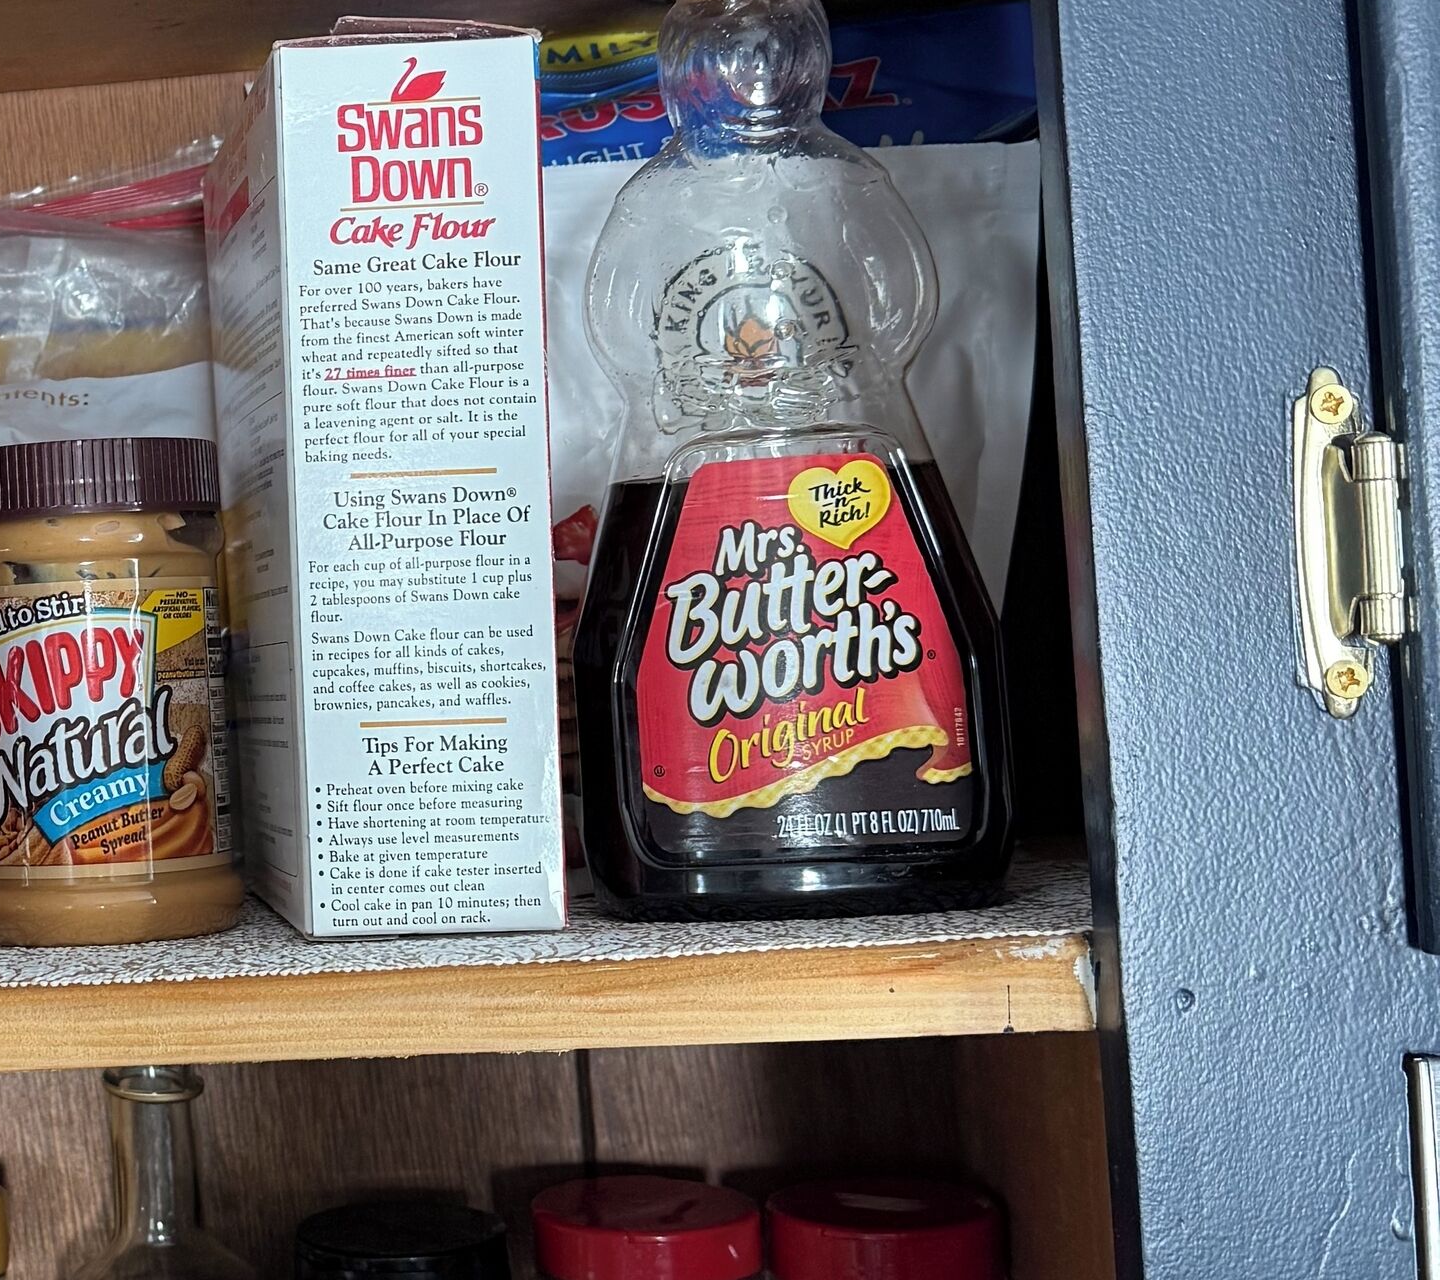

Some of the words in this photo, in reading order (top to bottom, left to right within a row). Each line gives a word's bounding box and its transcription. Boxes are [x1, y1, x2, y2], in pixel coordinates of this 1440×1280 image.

[329, 216, 404, 248] Cake
[406, 213, 496, 250] Flour
[313, 259, 361, 276] Same
[367, 256, 417, 272] Great
[422, 253, 468, 270] Cake
[473, 251, 521, 268] Flour
[334, 491, 385, 510] Using
[391, 489, 447, 505] Swans
[808, 477, 872, 502] Thick
[323, 514, 369, 530] Cake
[375, 511, 422, 528] Flour
[428, 510, 447, 526] In
[453, 507, 501, 525] Place
[507, 505, 531, 523] Of
[819, 501, 870, 528] Rich!
[348, 533, 453, 552] All-Purpose
[460, 529, 507, 546] Flour
[716, 521, 805, 576] Mrs.
[9, 607, 32, 626] to
[691, 602, 918, 722] worth's
[362, 737, 399, 757] Tips
[405, 736, 435, 752] For
[440, 734, 508, 754] Making
[710, 687, 870, 784] Original
[801, 728, 855, 761] SYRUP
[369, 760, 382, 776] A
[389, 758, 453, 774] Perfect
[458, 755, 505, 773] Cake
[50, 773, 149, 826] Creamy
[71, 819, 120, 850] Peanut
[122, 807, 165, 828] Butter
[852, 813, 867, 834] PT
[870, 813, 879, 832] 8
[882, 812, 896, 833] FL
[898, 809, 918, 834] OZ)
[922, 808, 960, 831] 710mL
[100, 828, 147, 855] Spread
